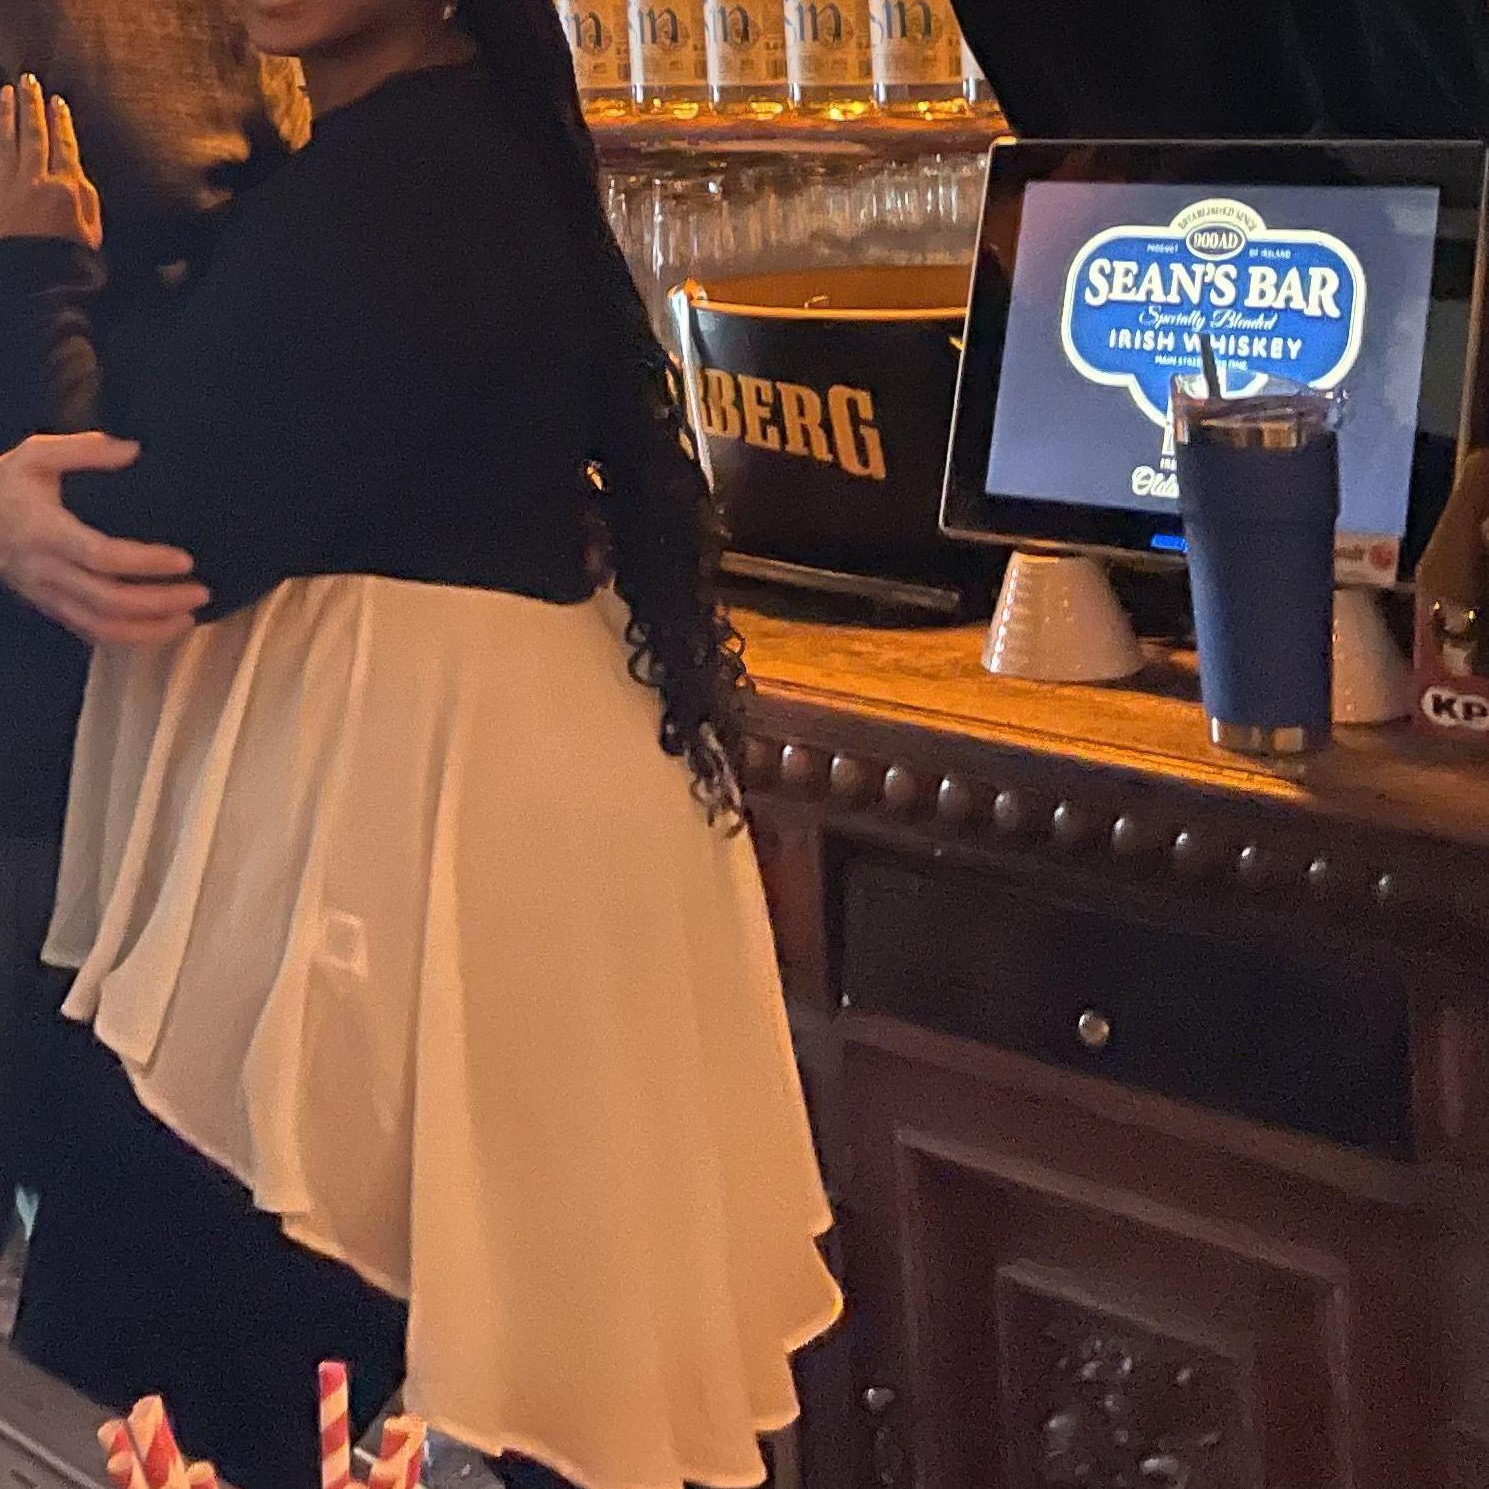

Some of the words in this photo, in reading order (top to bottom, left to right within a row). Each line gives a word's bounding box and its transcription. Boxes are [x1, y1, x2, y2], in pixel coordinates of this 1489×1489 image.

[1084, 258, 1237, 308] SEAN'S
[1244, 266, 1341, 319] BAR
[1209, 309, 1279, 332] Blended
[1109, 328, 1176, 352] IRISH
[1183, 332, 1303, 360] WHISKEY
[691, 367, 886, 481] BERG
[1432, 694, 1488, 722] KP
